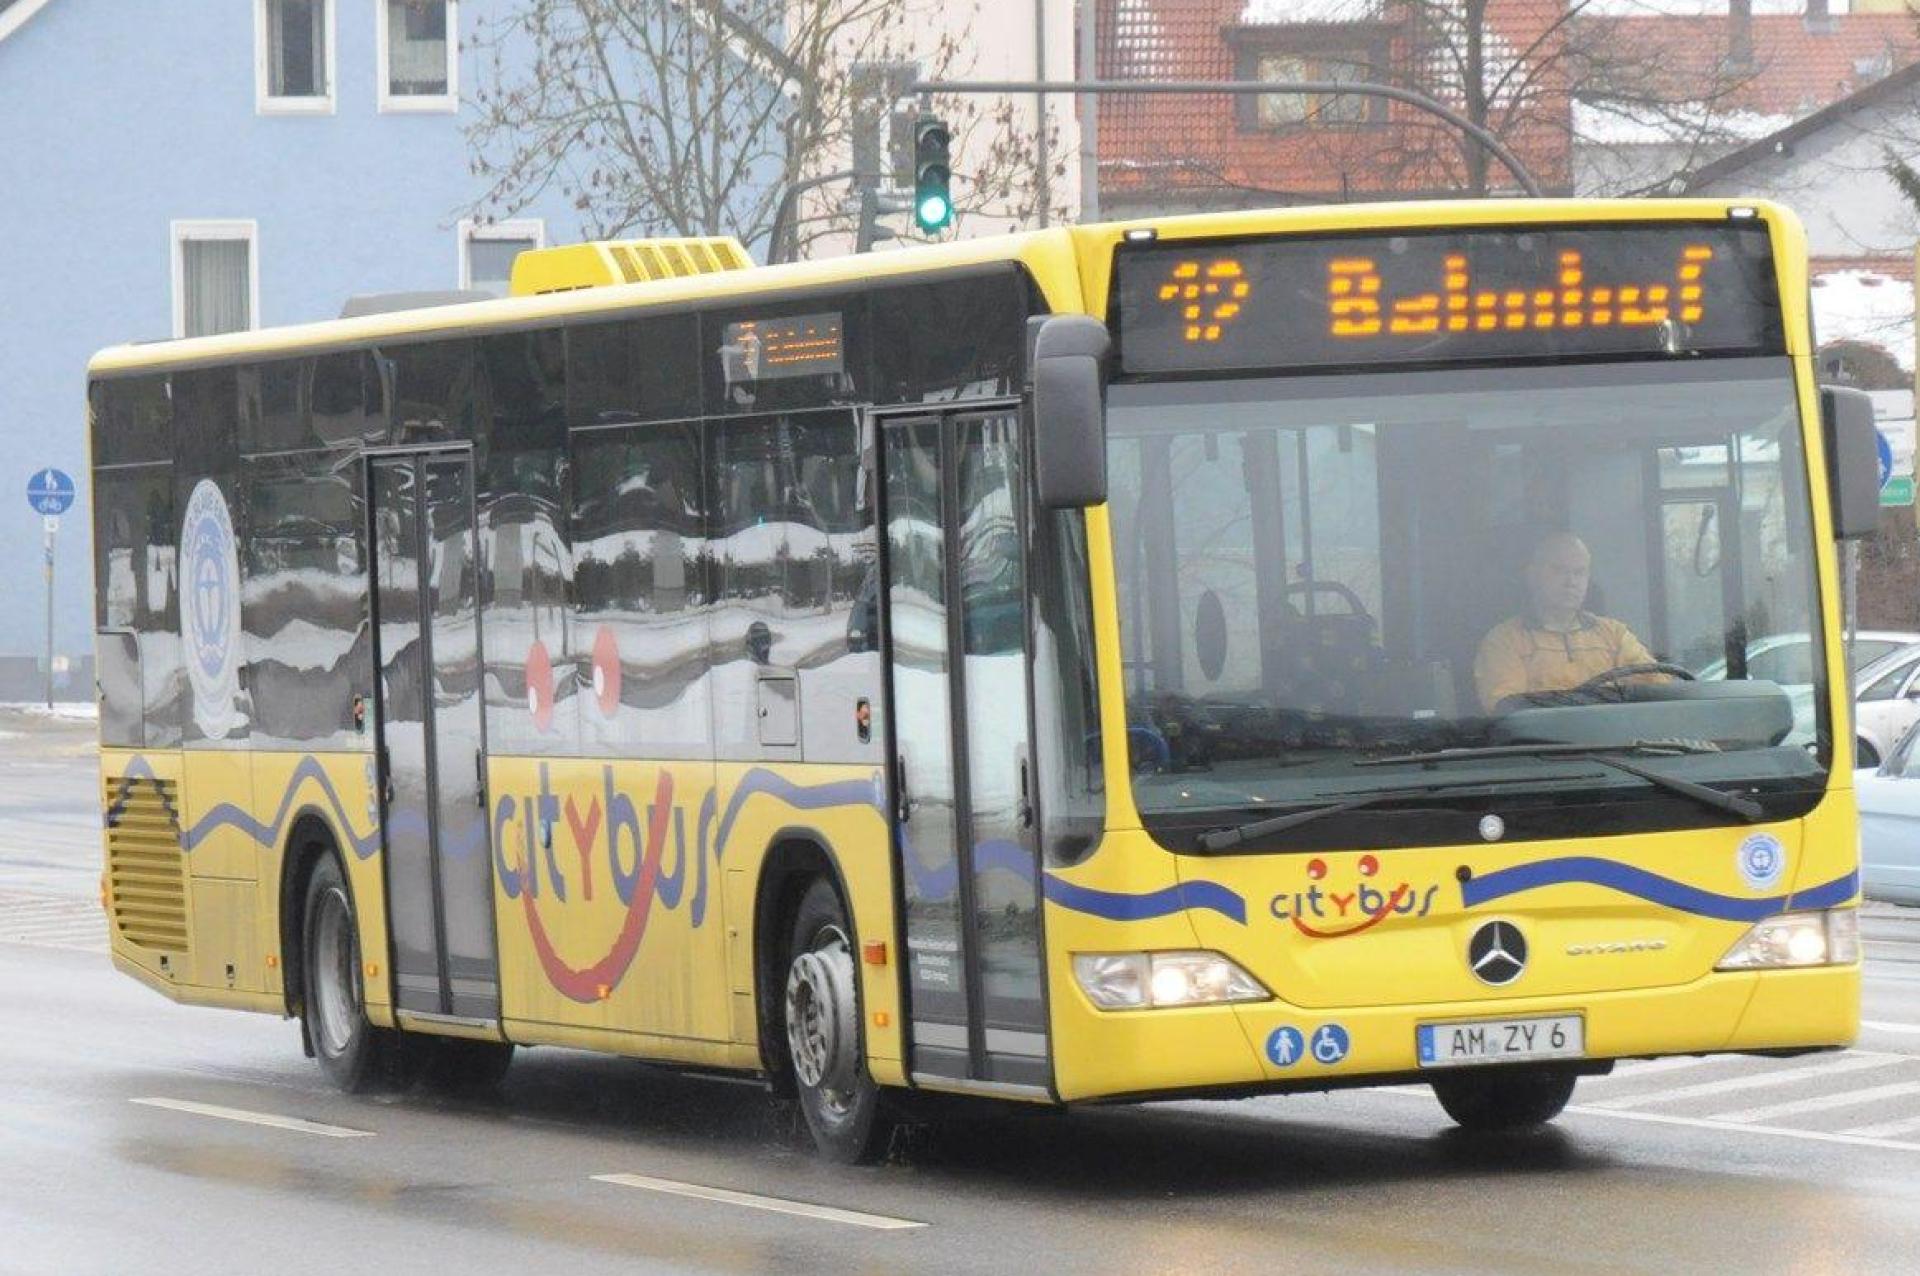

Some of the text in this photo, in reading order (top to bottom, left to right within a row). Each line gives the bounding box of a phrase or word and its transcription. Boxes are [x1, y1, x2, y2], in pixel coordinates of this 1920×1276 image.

[1452, 1022, 1566, 1057] AM ZY 6
